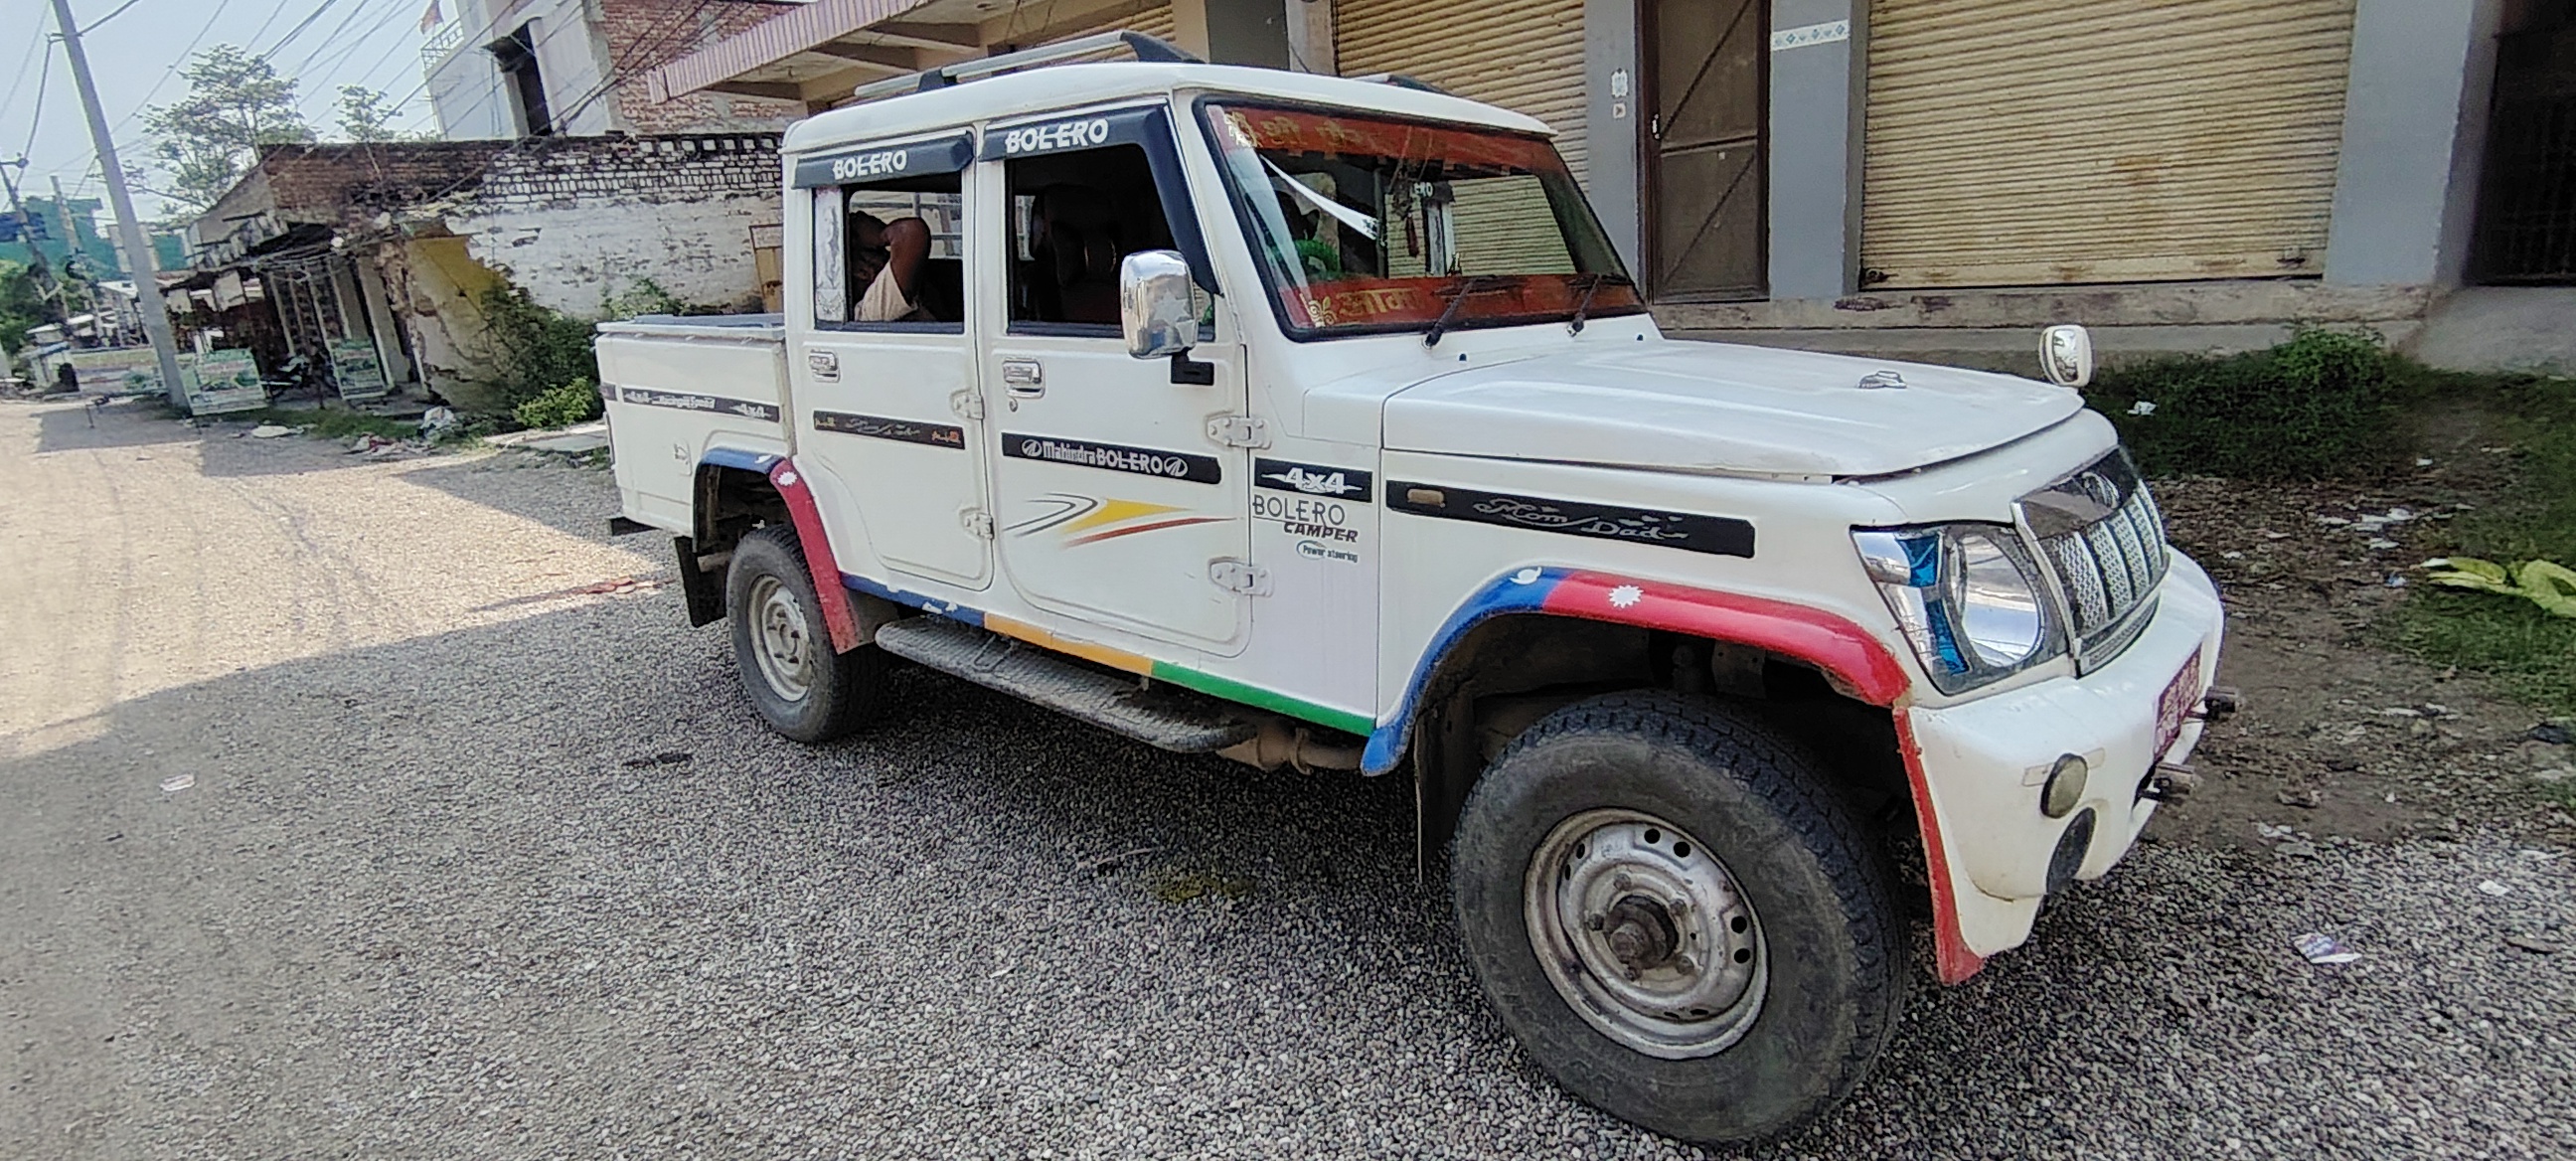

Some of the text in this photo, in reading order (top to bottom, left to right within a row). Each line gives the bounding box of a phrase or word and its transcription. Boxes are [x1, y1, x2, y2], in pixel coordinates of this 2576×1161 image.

[1005, 118, 1109, 154] BOLERO
[832, 149, 907, 180] BOLERO
[1043, 440, 1164, 475] Mahindra BOLERO
[1284, 466, 1346, 495] 4x4
[1252, 494, 1346, 527] BOLERO
[1283, 521, 1359, 543] CAMPER
[1302, 545, 1327, 557] Power
